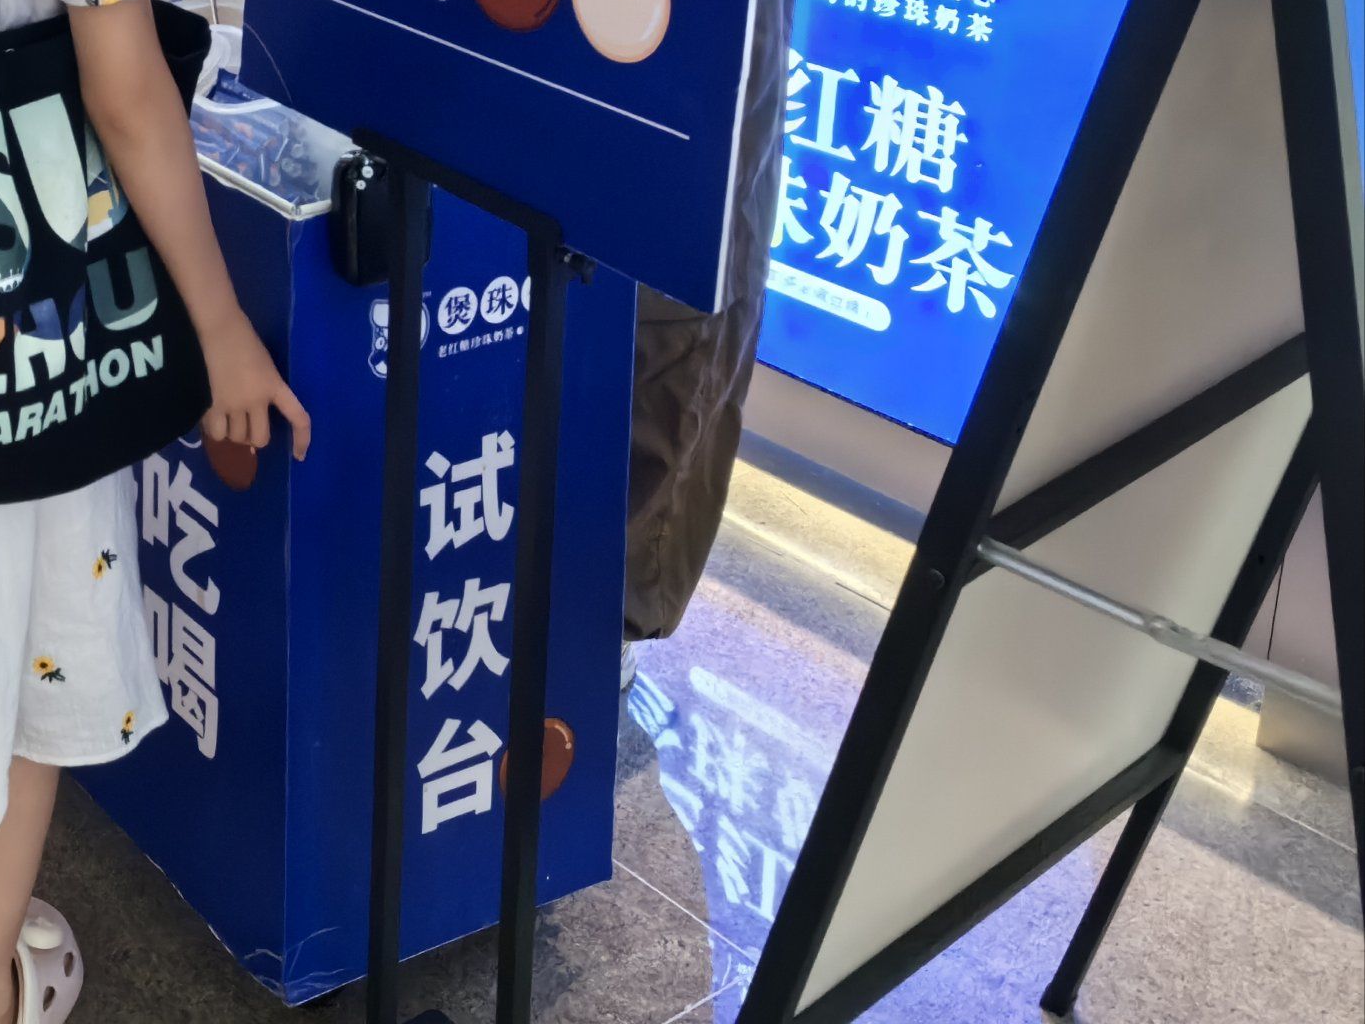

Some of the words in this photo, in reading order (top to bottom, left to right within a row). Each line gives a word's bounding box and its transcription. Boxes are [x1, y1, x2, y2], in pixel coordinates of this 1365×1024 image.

[784, 46, 969, 194] 红糖
[440, 278, 520, 332] 煲珠
[414, 429, 516, 835] 试饮台
